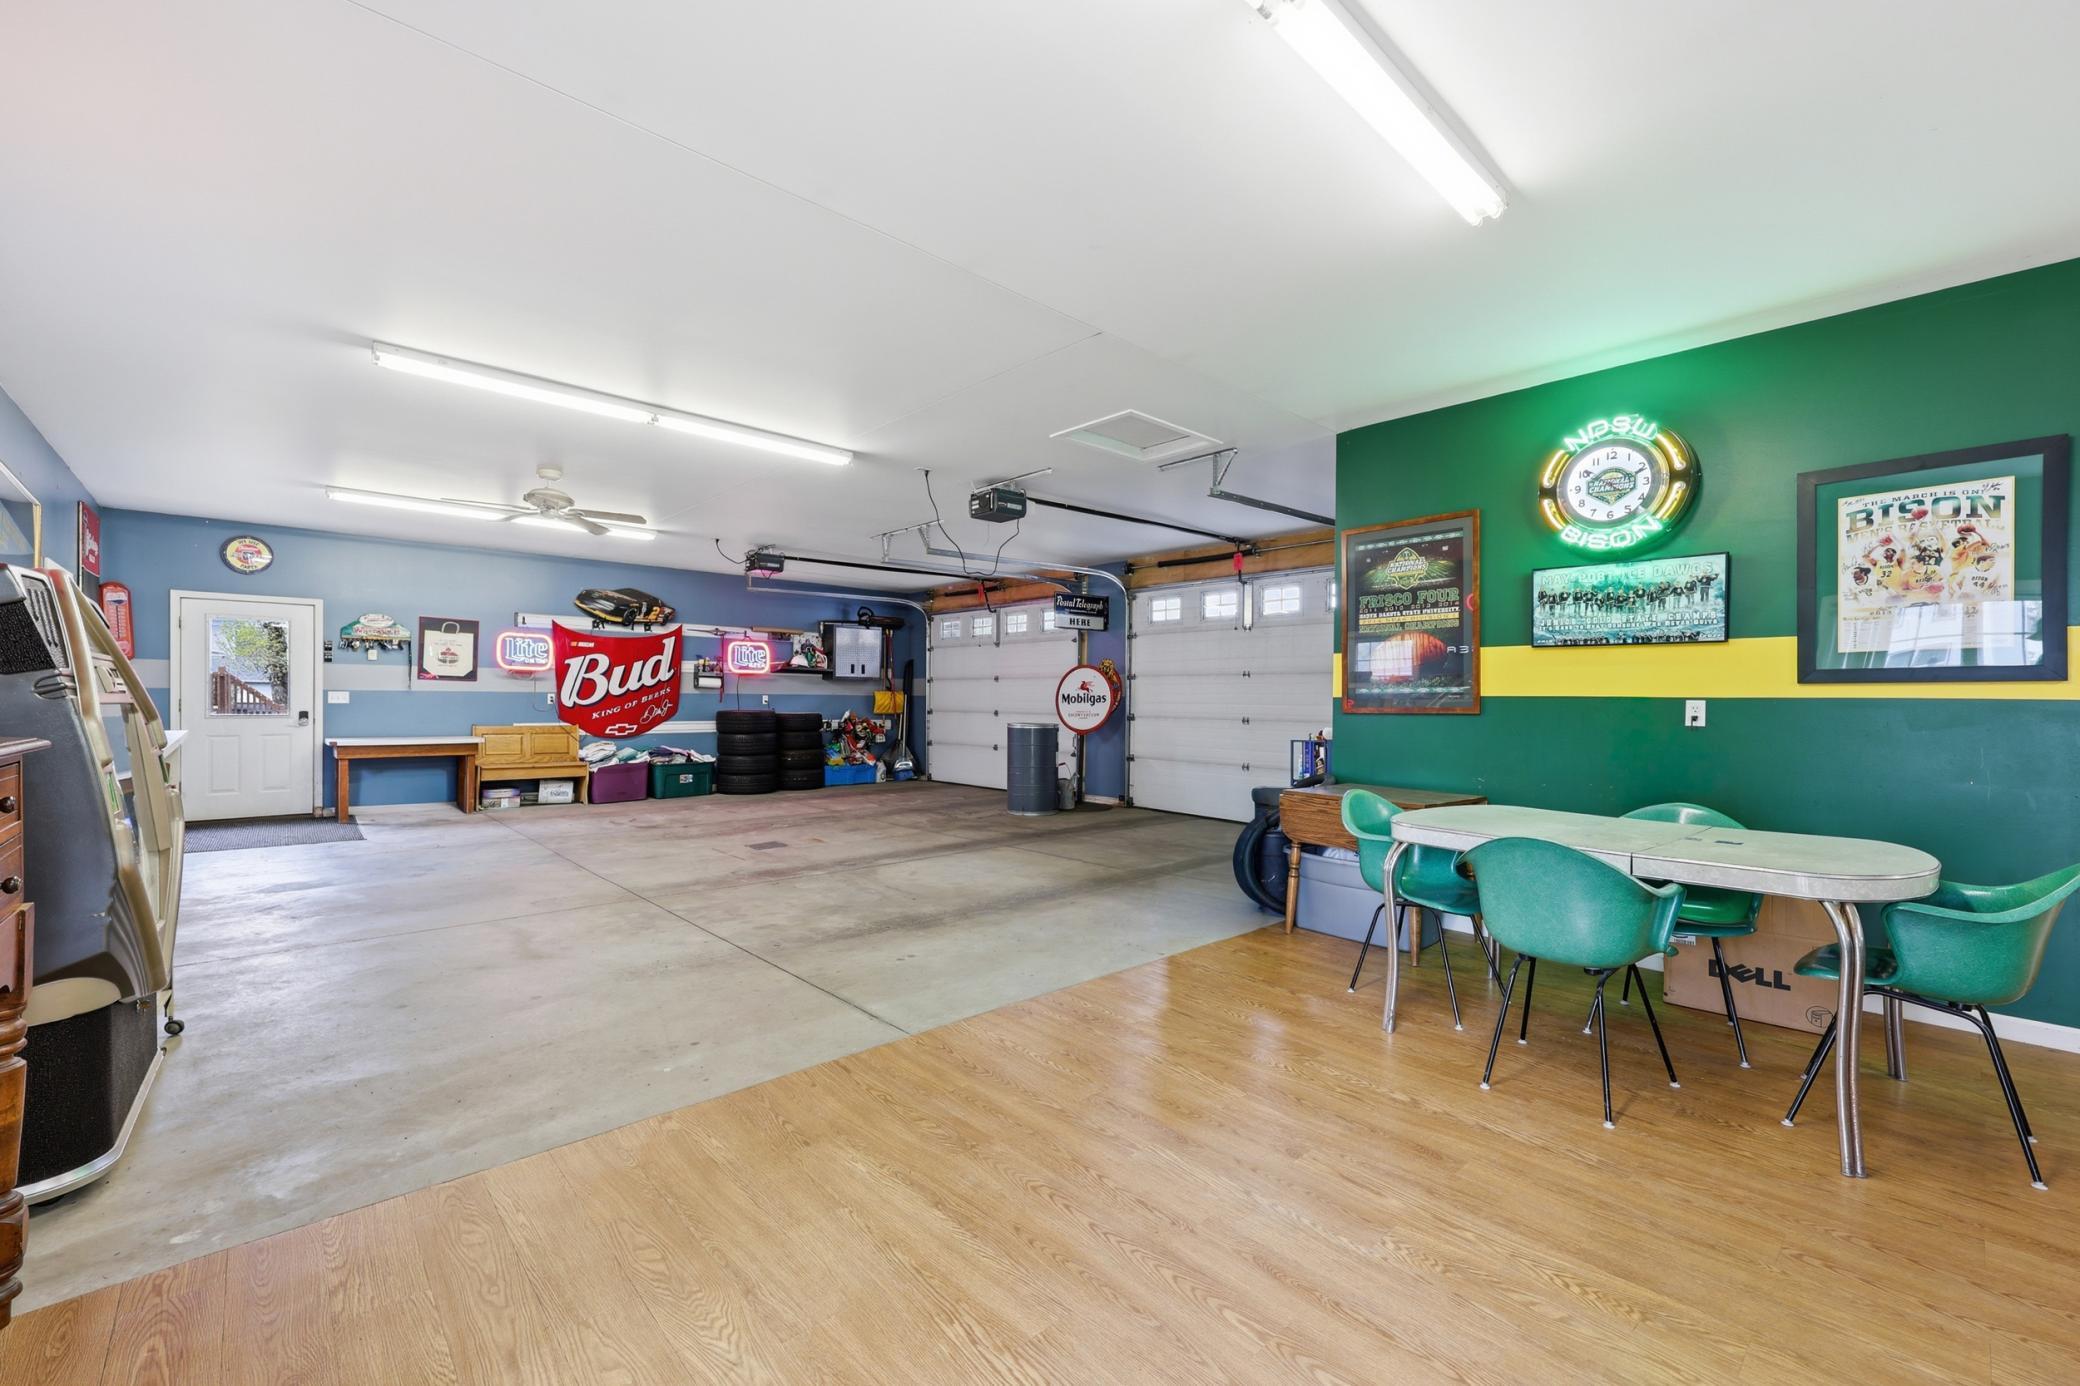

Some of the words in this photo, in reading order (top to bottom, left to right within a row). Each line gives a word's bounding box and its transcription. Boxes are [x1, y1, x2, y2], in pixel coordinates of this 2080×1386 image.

[1606, 451, 1618, 461] 12
[1627, 453, 1631, 462] 1
[1592, 458, 1600, 466] 11
[1579, 470, 1589, 479] 10
[1642, 477, 1650, 486] 3
[1574, 486, 1581, 494] 9
[1637, 492, 1645, 501] 4
[1892, 492, 1937, 502] MARCH
[1579, 499, 1585, 507] 8
[1590, 509, 1597, 517] 7
[1607, 510, 1614, 519] 6
[1624, 505, 1632, 514] 5
[1846, 495, 2006, 534] BISON
[1560, 513, 1663, 549] BISON
[1654, 562, 1713, 578] DAWGS
[1056, 595, 1076, 608] Postal
[1076, 598, 1104, 611] Telegraph
[1360, 592, 1413, 609] FRISCO
[1417, 587, 1460, 604] FOUR
[648, 606, 660, 620] 2
[1668, 611, 1717, 620] CHAMPS
[1069, 617, 1091, 627] HERE
[504, 638, 549, 661] Lite
[734, 645, 767, 666] Lite
[560, 637, 677, 707] Bud
[591, 706, 621, 720] KING
[624, 699, 639, 709] OF
[641, 687, 672, 703] BEERS
[1061, 693, 1107, 707] Mobilgas
[1708, 959, 1791, 991] DELL
